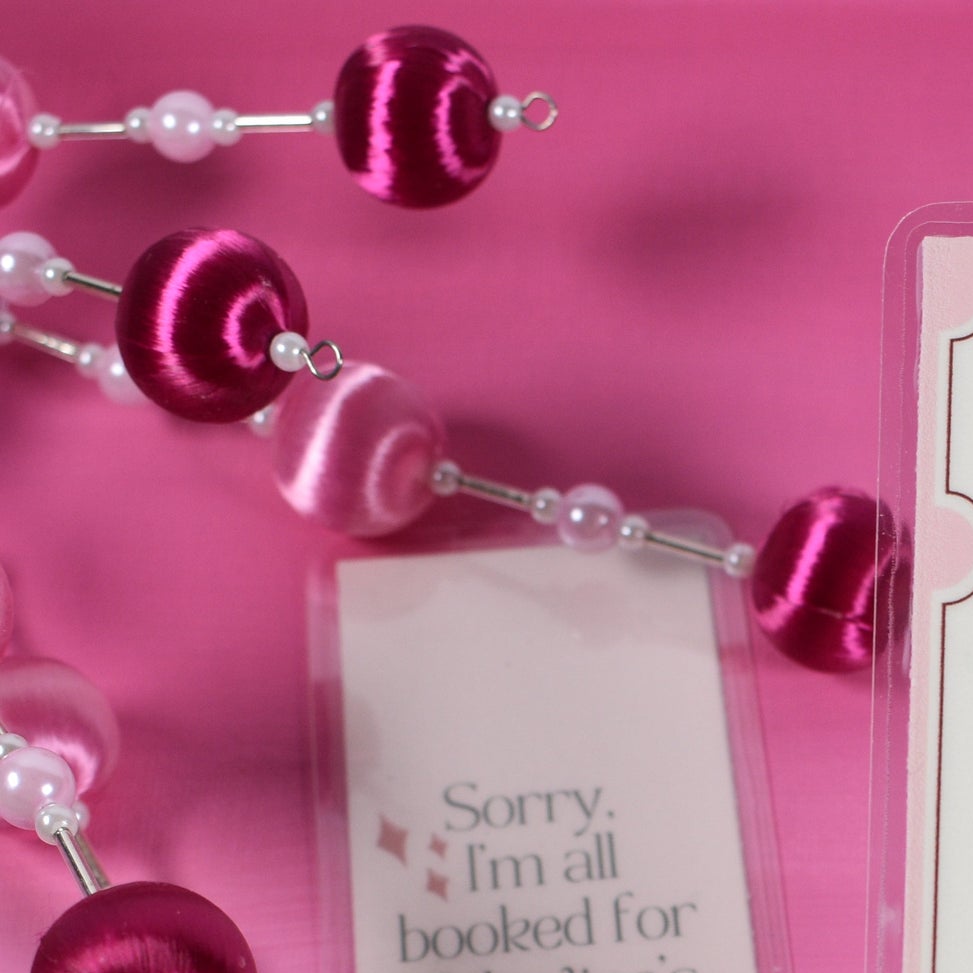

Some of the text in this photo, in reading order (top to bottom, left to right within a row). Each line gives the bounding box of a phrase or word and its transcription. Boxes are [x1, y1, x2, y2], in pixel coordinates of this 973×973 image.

[466, 830, 619, 893] I'm all
[398, 891, 697, 964] booked for
